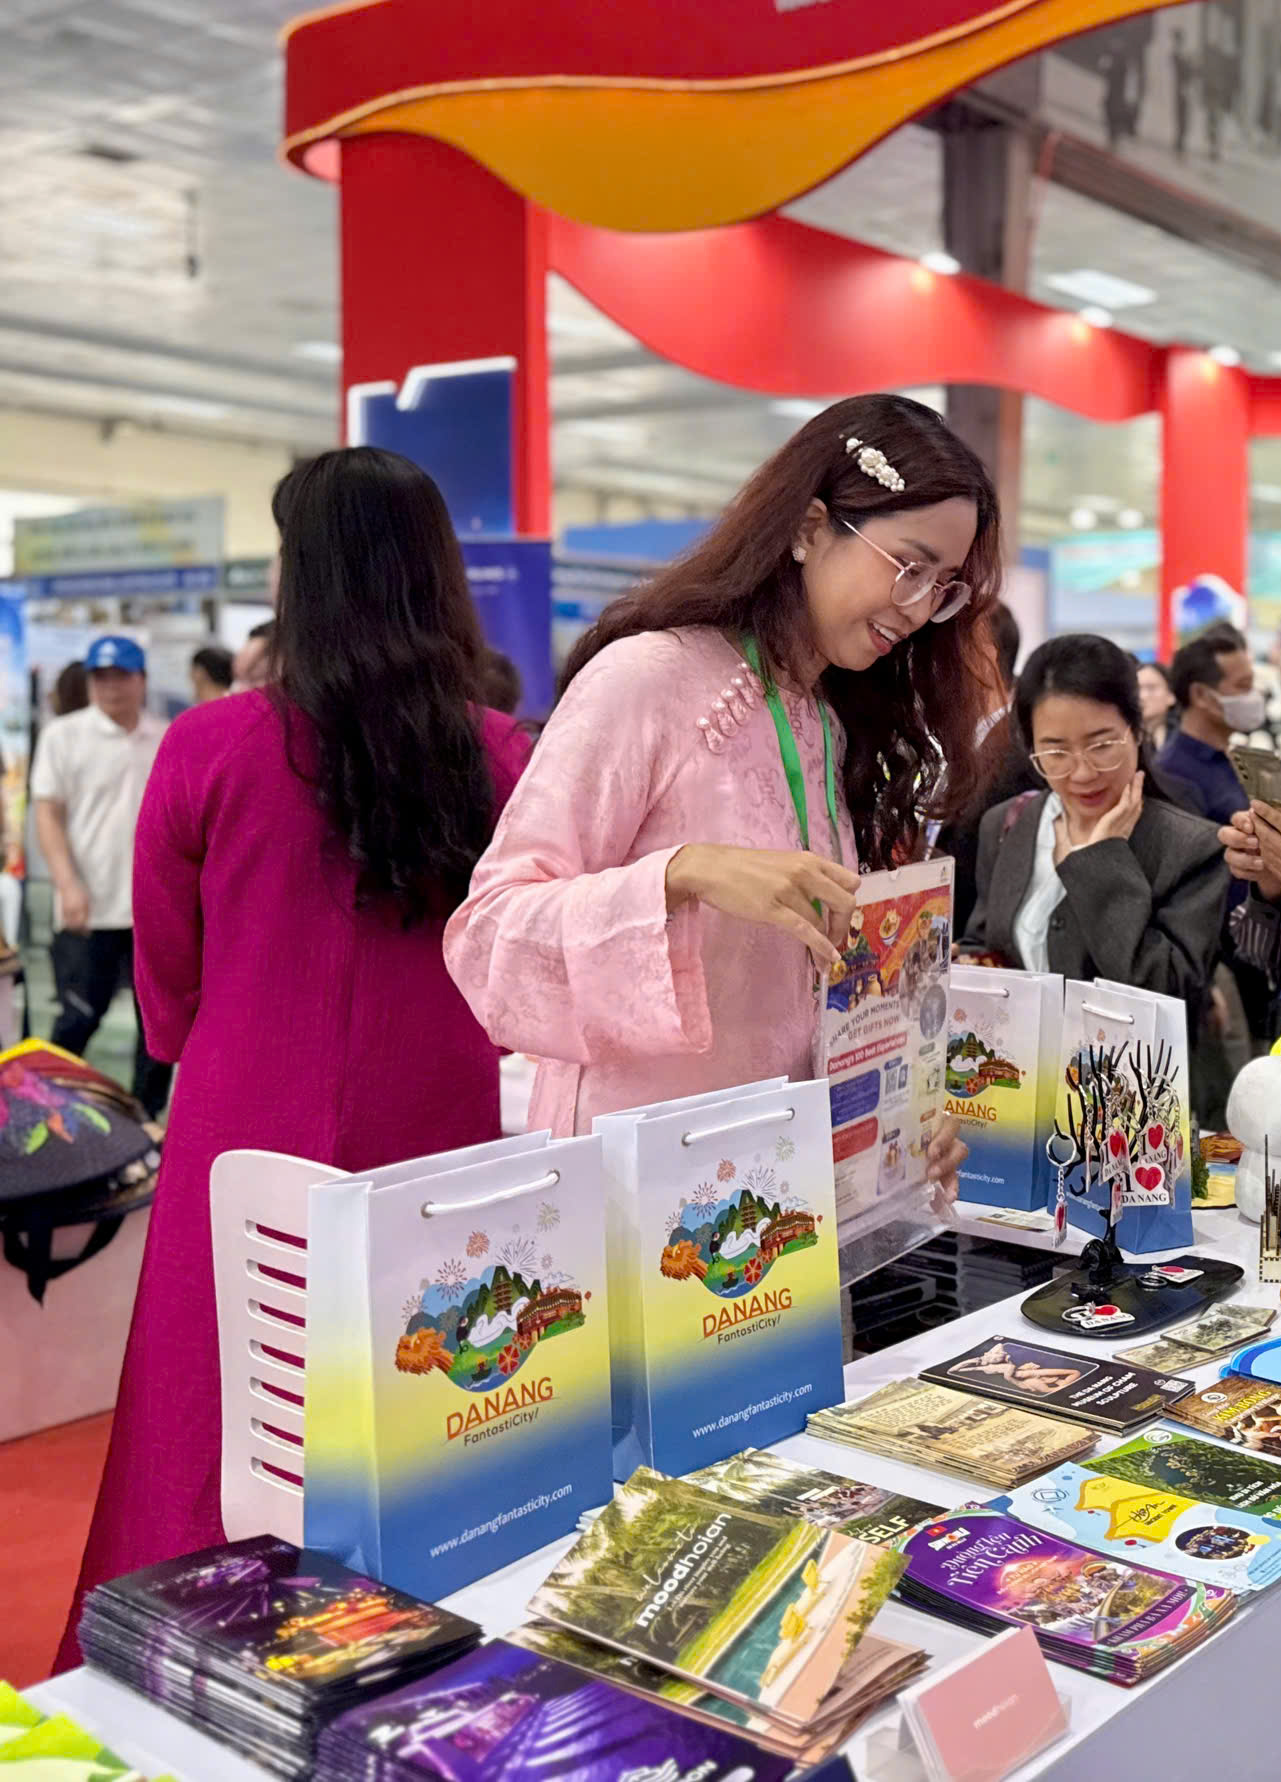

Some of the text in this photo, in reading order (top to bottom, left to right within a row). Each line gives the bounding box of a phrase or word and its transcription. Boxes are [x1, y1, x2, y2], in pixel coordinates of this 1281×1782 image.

[944, 1100, 998, 1122] ANANG
[1121, 1192, 1168, 1204] DA NANG
[703, 1288, 793, 1338] DANANG
[1096, 1382, 1139, 1406] SCULPTURE
[1113, 1371, 1137, 1388] CHAM
[446, 1376, 553, 1441] DANANG
[692, 1383, 813, 1438] www.danangfantasticity.com
[429, 1483, 572, 1558] www.danangfantasticity.com
[859, 1515, 909, 1544] SELF
[636, 1512, 732, 1628] moodhoian
